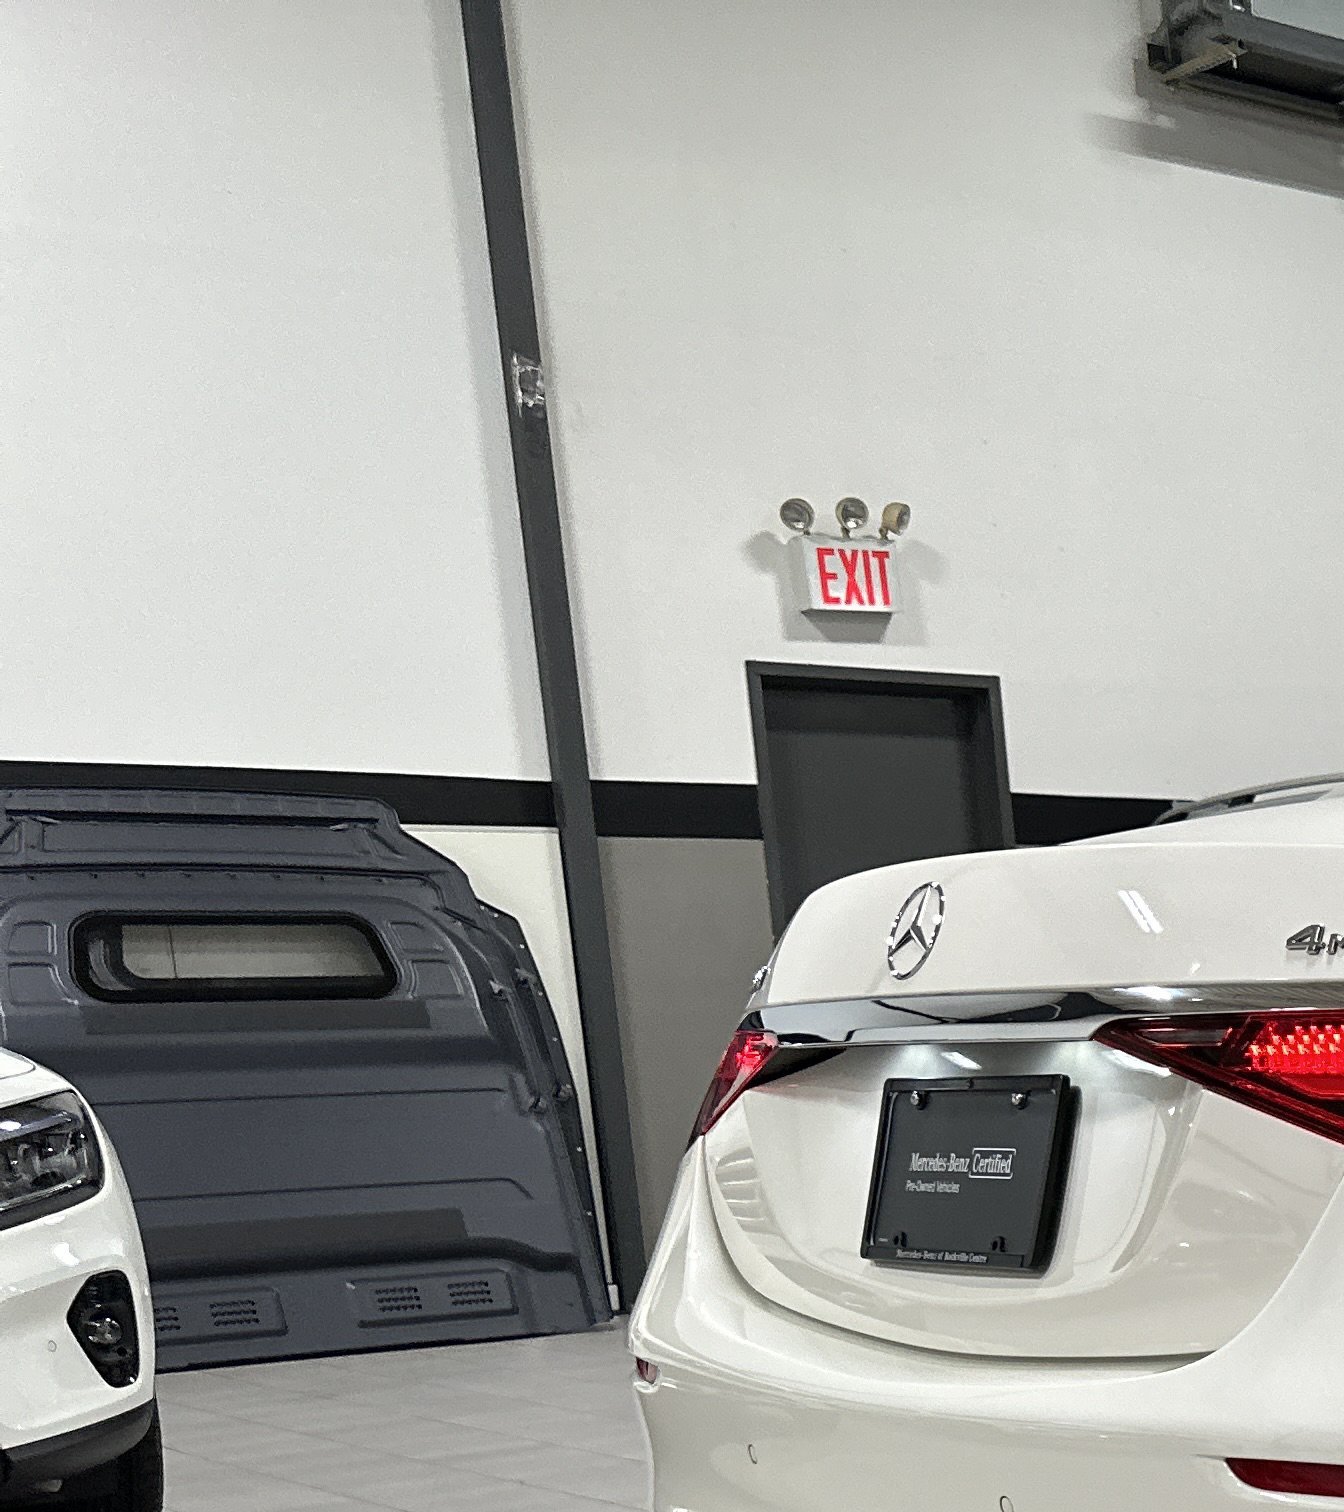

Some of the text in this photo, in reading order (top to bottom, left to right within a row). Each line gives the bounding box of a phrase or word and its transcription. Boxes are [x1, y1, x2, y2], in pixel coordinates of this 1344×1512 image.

[816, 547, 892, 608] EXIT
[909, 1152, 1013, 1173] Mercedes-Benz Certified
[905, 1180, 936, 1192] Pre-Owned
